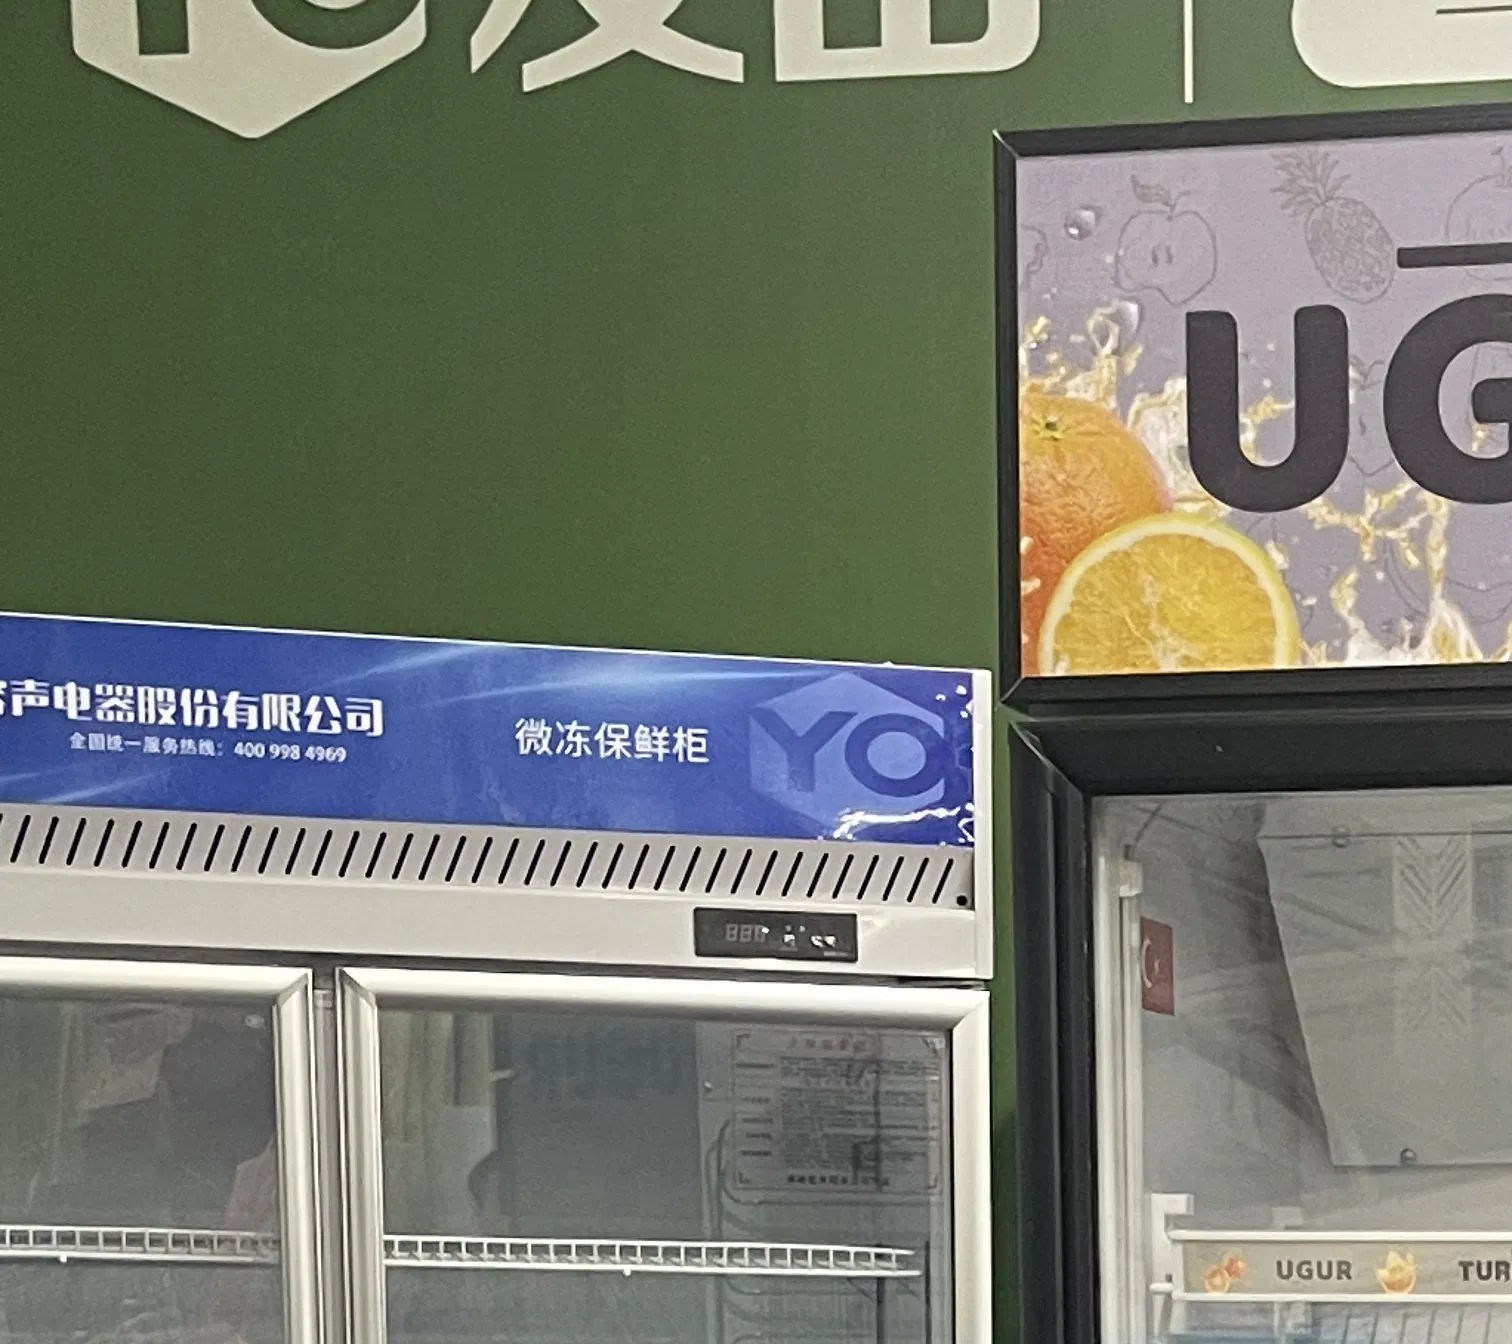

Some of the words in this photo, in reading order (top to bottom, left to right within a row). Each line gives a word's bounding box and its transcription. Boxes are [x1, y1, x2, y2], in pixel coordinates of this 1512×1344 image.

[0, 678, 384, 738] 声电器股份有限公司
[233, 741, 265, 759] 400
[269, 742, 301, 761] 998
[514, 716, 711, 764] 微冻保鲜柜
[1276, 1259, 1353, 1281] UGUR
